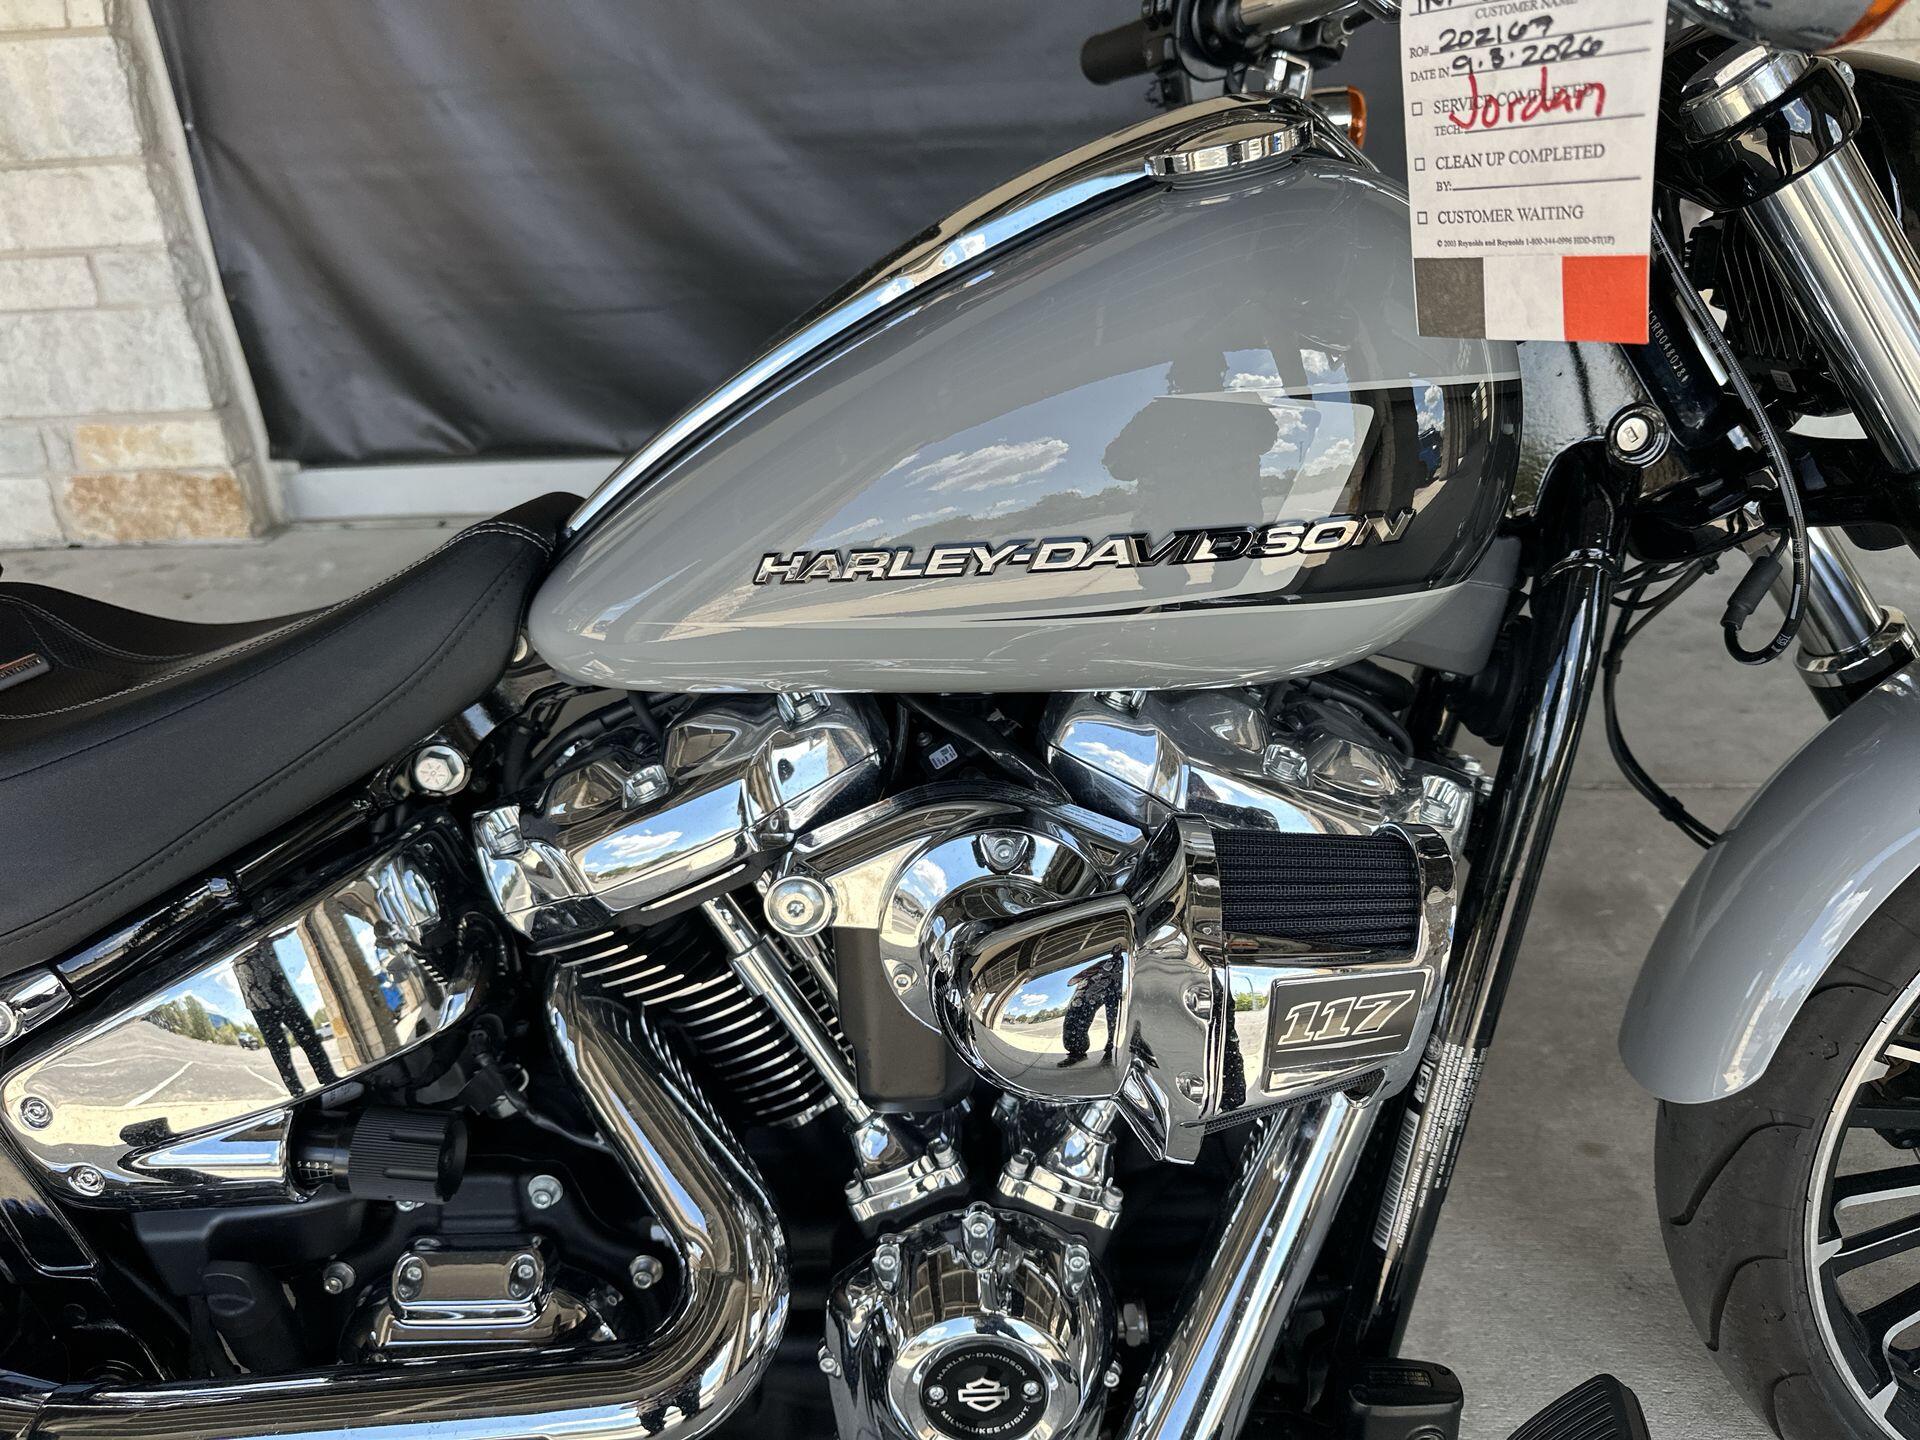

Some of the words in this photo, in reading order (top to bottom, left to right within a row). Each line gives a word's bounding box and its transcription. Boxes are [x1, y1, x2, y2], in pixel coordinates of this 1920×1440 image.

[1475, 1, 1538, 19] CUSTOMER
[1409, 46, 1429, 58] RO#
[1410, 69, 1436, 82] DATE
[1438, 67, 1450, 79] IN
[1449, 66, 1606, 129] Jordan
[1435, 153, 1483, 170] CLEAN
[1485, 152, 1505, 167] UP
[1508, 143, 1606, 164] COMPLETED
[1436, 181, 1452, 192] BY:
[1437, 208, 1515, 225] CUSTOMER
[1517, 205, 1584, 221] WAITING
[752, 508, 1416, 586] HARLEY-DAVIDSON
[1277, 989, 1416, 1046] 117
[937, 1353, 1027, 1380] HARLEY-DAVIDSON
[940, 1405, 1031, 1435] MILWAUKEE-EIGHT
